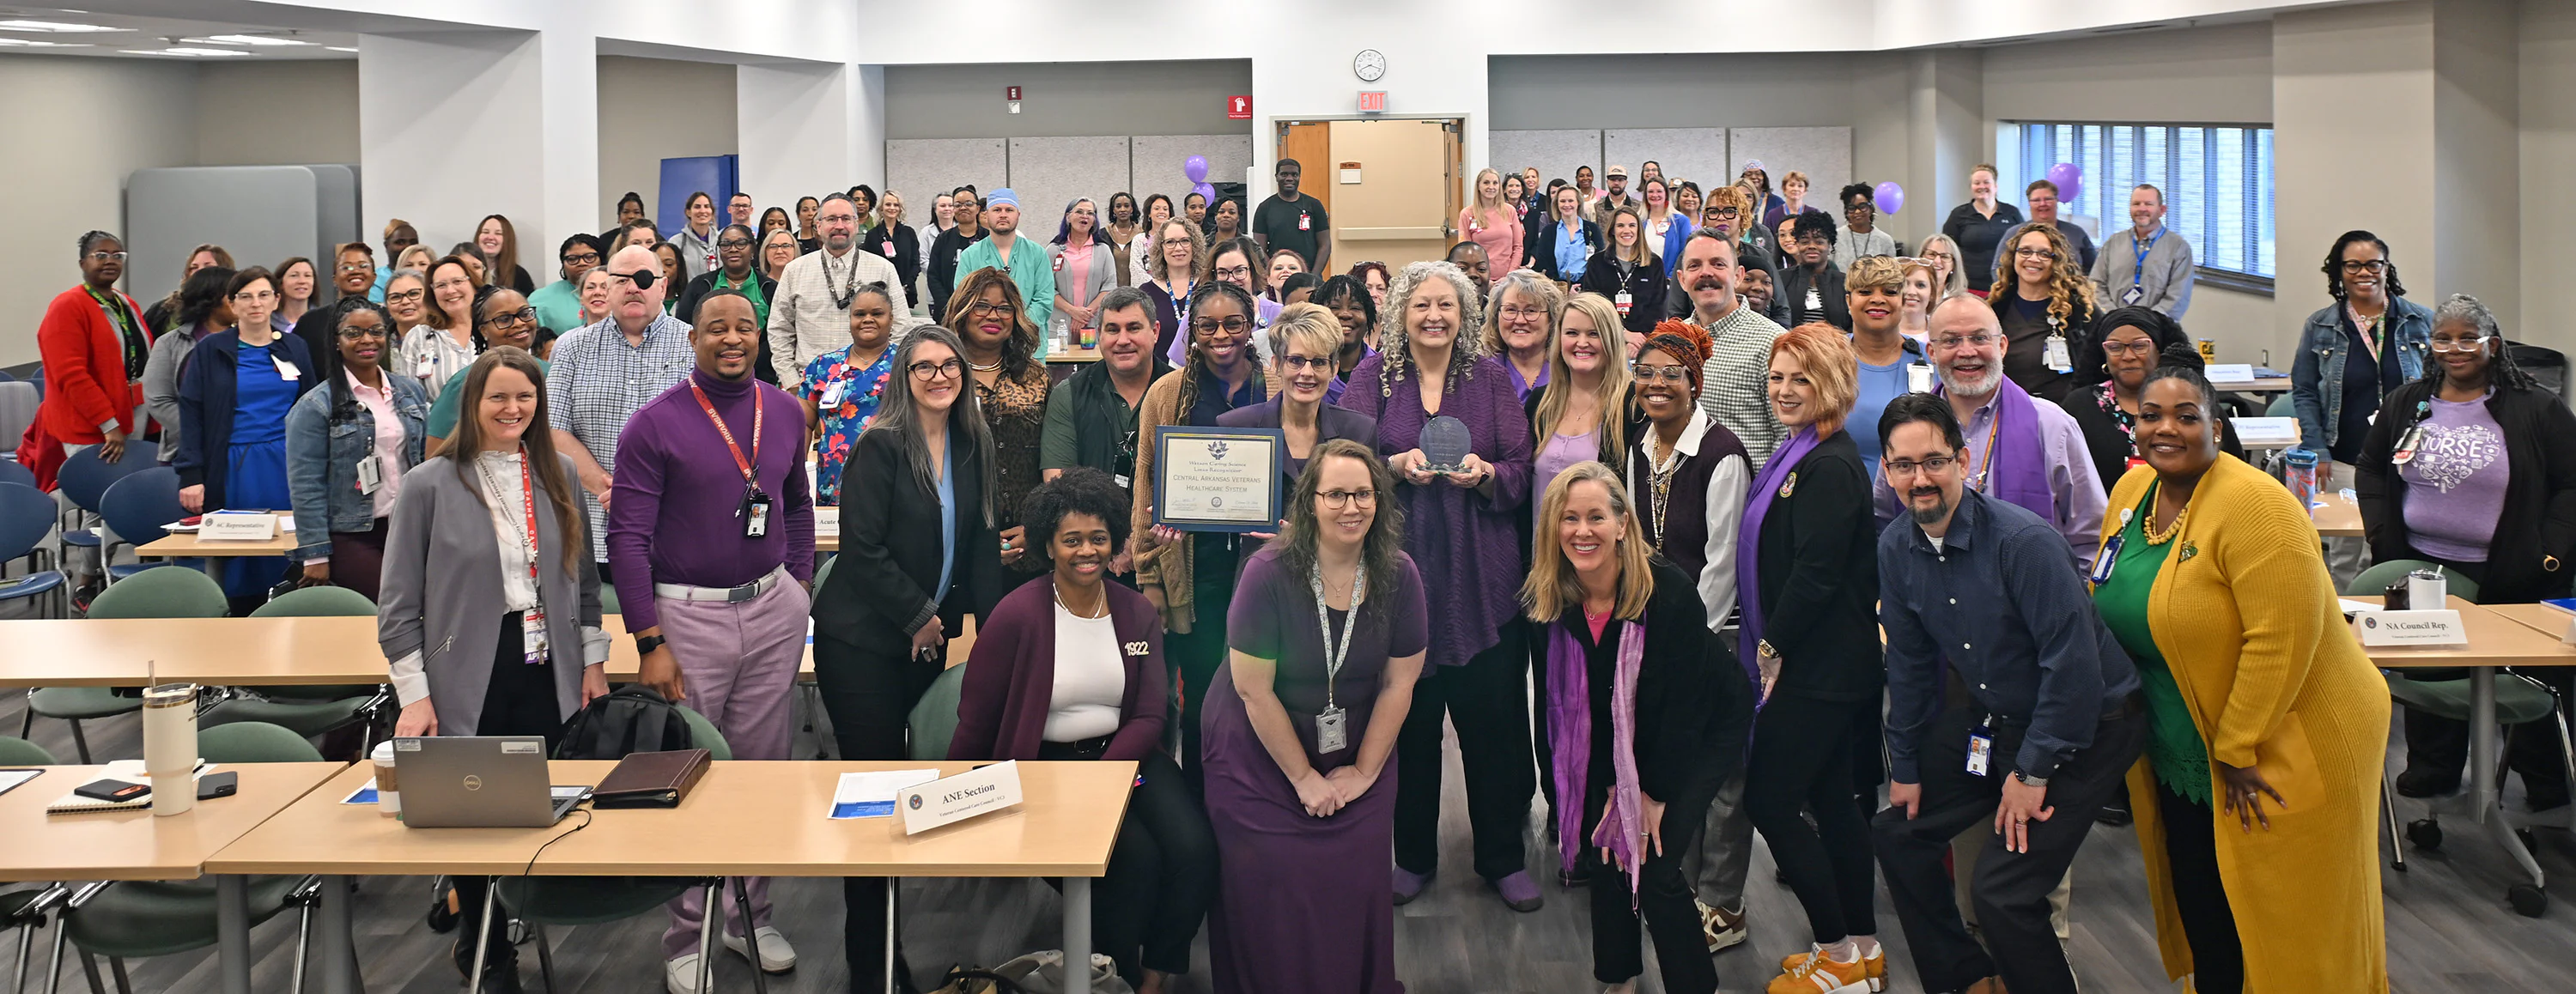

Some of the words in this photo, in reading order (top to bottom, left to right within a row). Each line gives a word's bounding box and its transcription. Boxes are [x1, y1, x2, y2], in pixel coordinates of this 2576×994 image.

[1360, 92, 1385, 111] EXIT
[708, 408, 735, 446] ARKANSAS
[2420, 435, 2484, 458] NURSE
[477, 457, 489, 476] Respect
[488, 476, 502, 498] Advocacy
[2432, 621, 2449, 631] Rep.
[1125, 640, 1150, 656] 1922
[942, 791, 963, 804] ANE
[963, 784, 996, 798] Section
